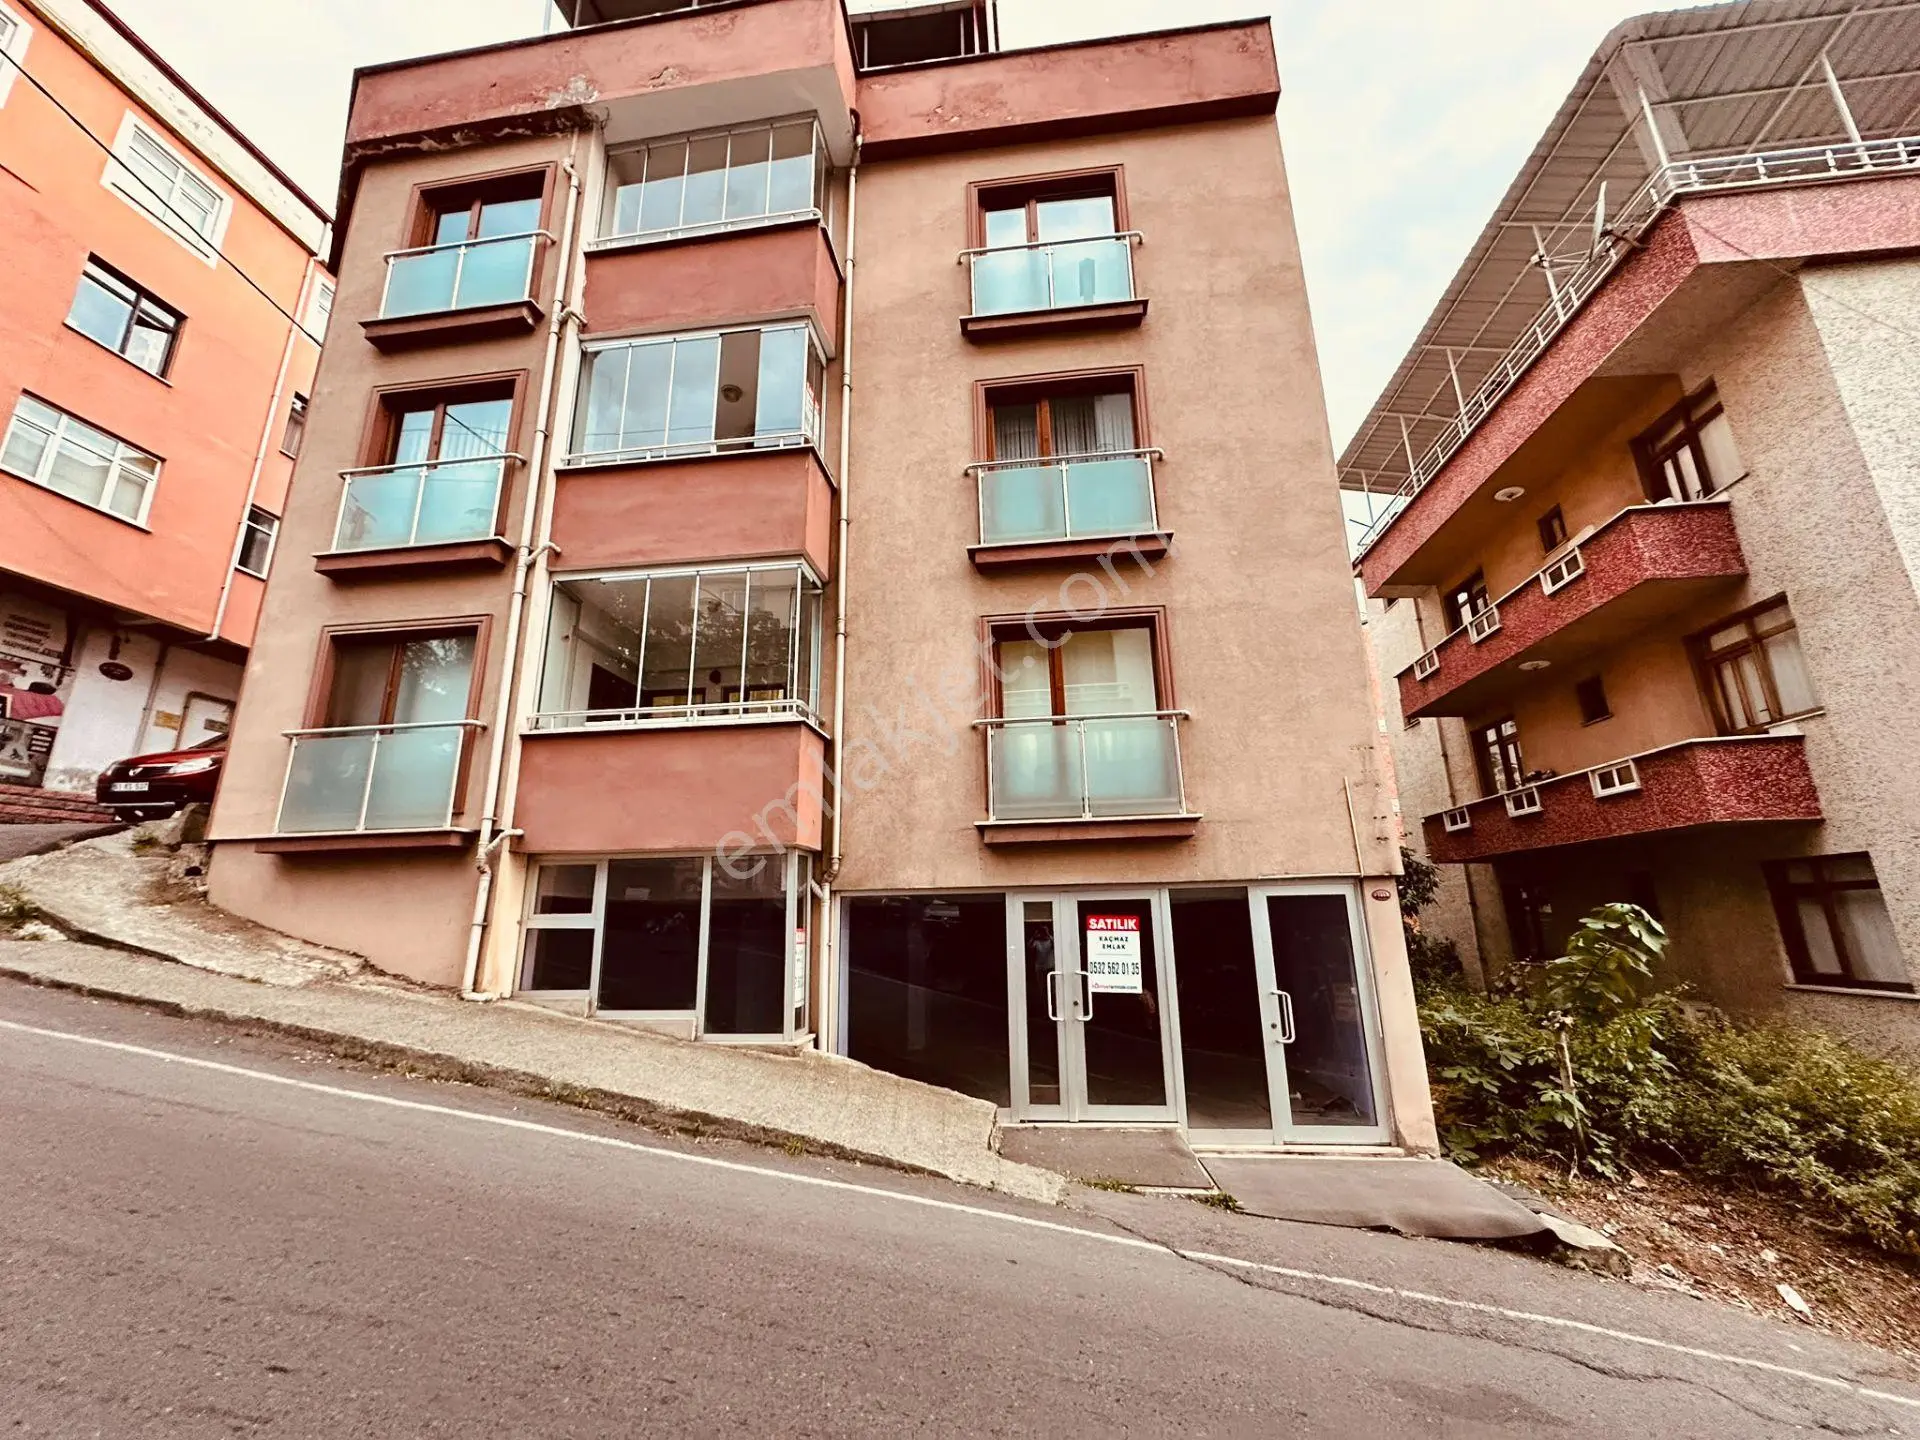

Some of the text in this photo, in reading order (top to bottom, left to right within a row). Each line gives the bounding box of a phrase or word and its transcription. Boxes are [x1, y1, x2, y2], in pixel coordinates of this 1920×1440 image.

[1089, 918, 1137, 930] SATILIK
[1089, 961, 1140, 975] 0532 562 01 35
